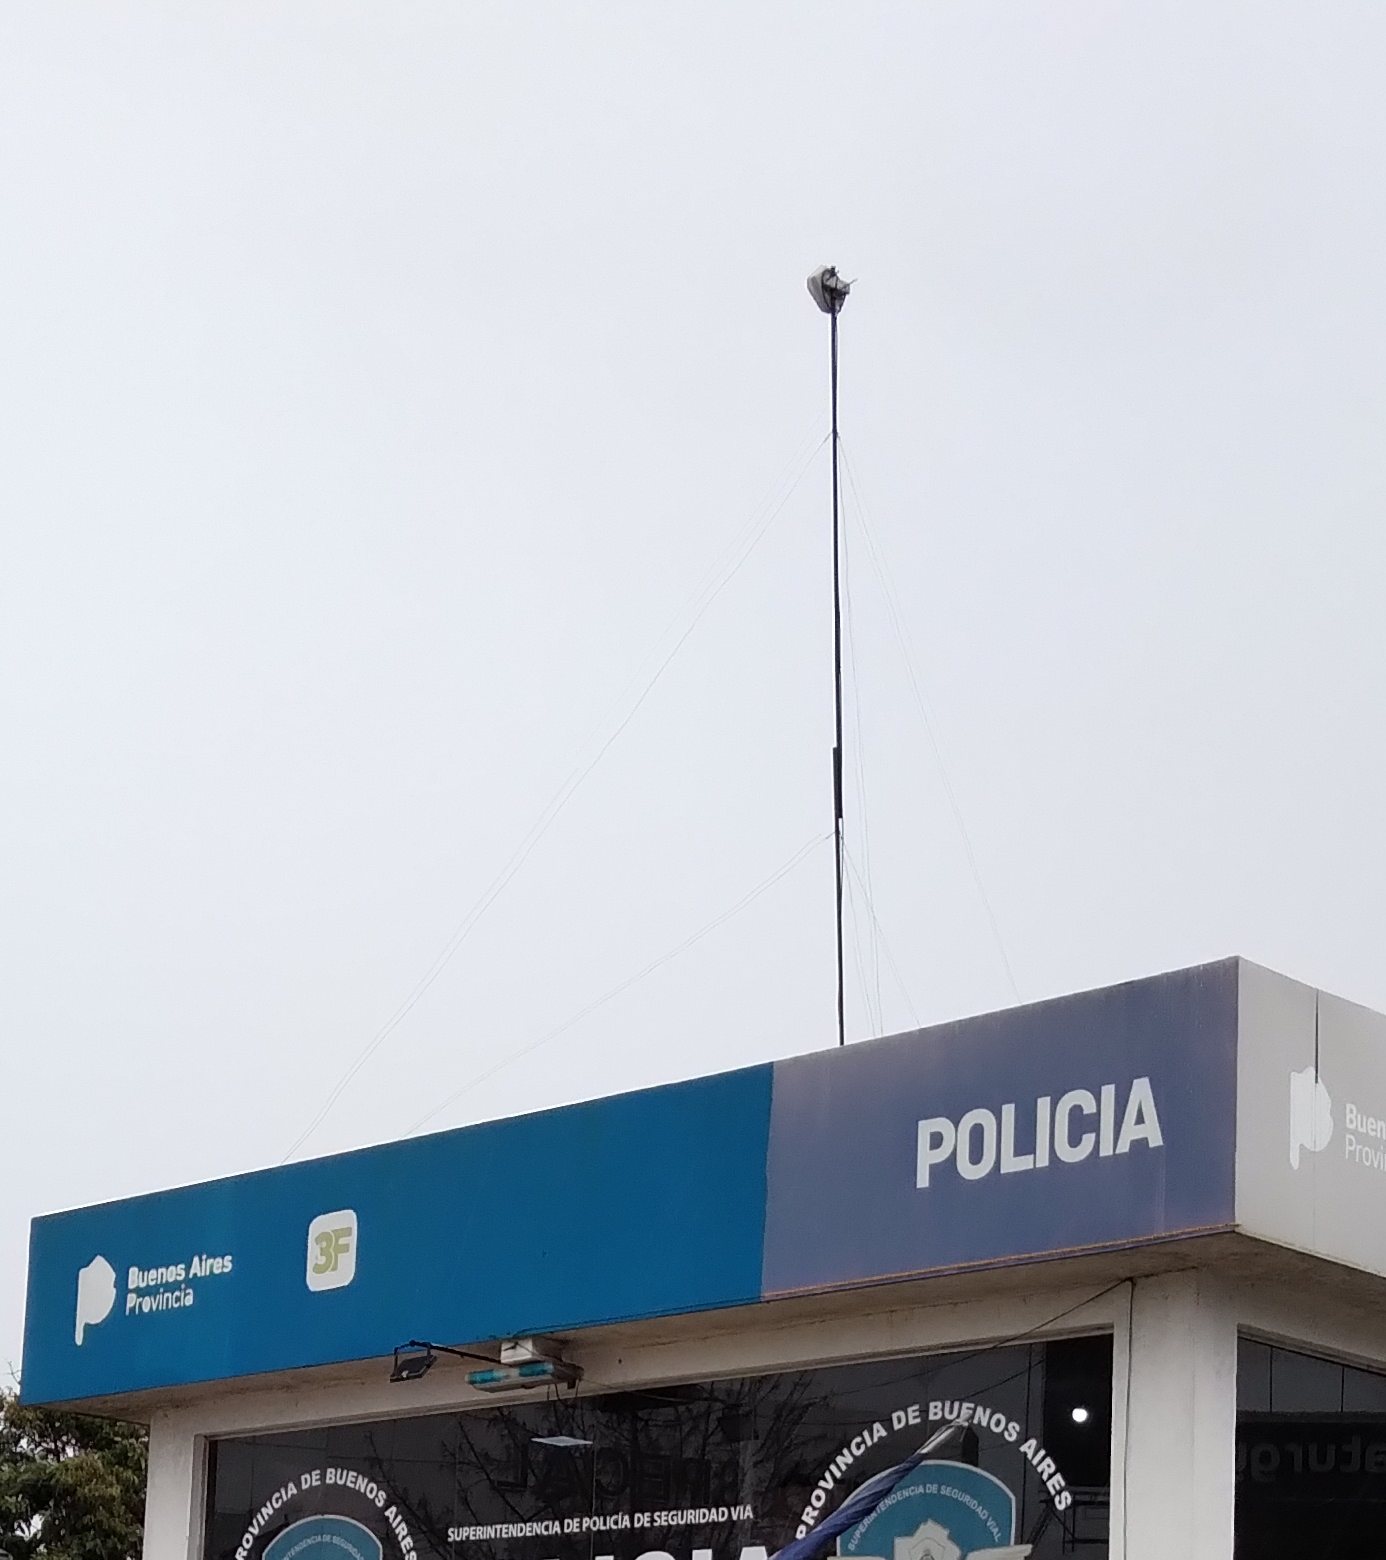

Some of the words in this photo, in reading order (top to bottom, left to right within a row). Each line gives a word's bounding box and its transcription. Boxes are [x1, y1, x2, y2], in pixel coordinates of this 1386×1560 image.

[916, 1076, 1164, 1189] POLICIA
[128, 1261, 186, 1290] Buenos
[189, 1254, 233, 1280] Aires
[312, 1226, 353, 1275] 3F
[126, 1285, 194, 1316] Provincia
[300, 1470, 321, 1490] DE
[326, 1467, 387, 1507] BUENOS
[795, 1421, 888, 1540] PROVINCIA
[891, 1405, 921, 1431] DE
[928, 1400, 1021, 1443] BUENOS
[1018, 1437, 1073, 1511] AIRES
[447, 1520, 561, 1542] SUPERINTENDENCIA
[563, 1517, 582, 1533] DE
[582, 1511, 631, 1532] POLICÍA
[634, 1513, 652, 1528] DE
[653, 1508, 728, 1527] SEGURIDAD
[730, 1504, 754, 1520] VIA
[926, 1483, 938, 1494] DE
[940, 1485, 990, 1521] SEGURIDAD
[986, 1516, 1003, 1542] VIAL
